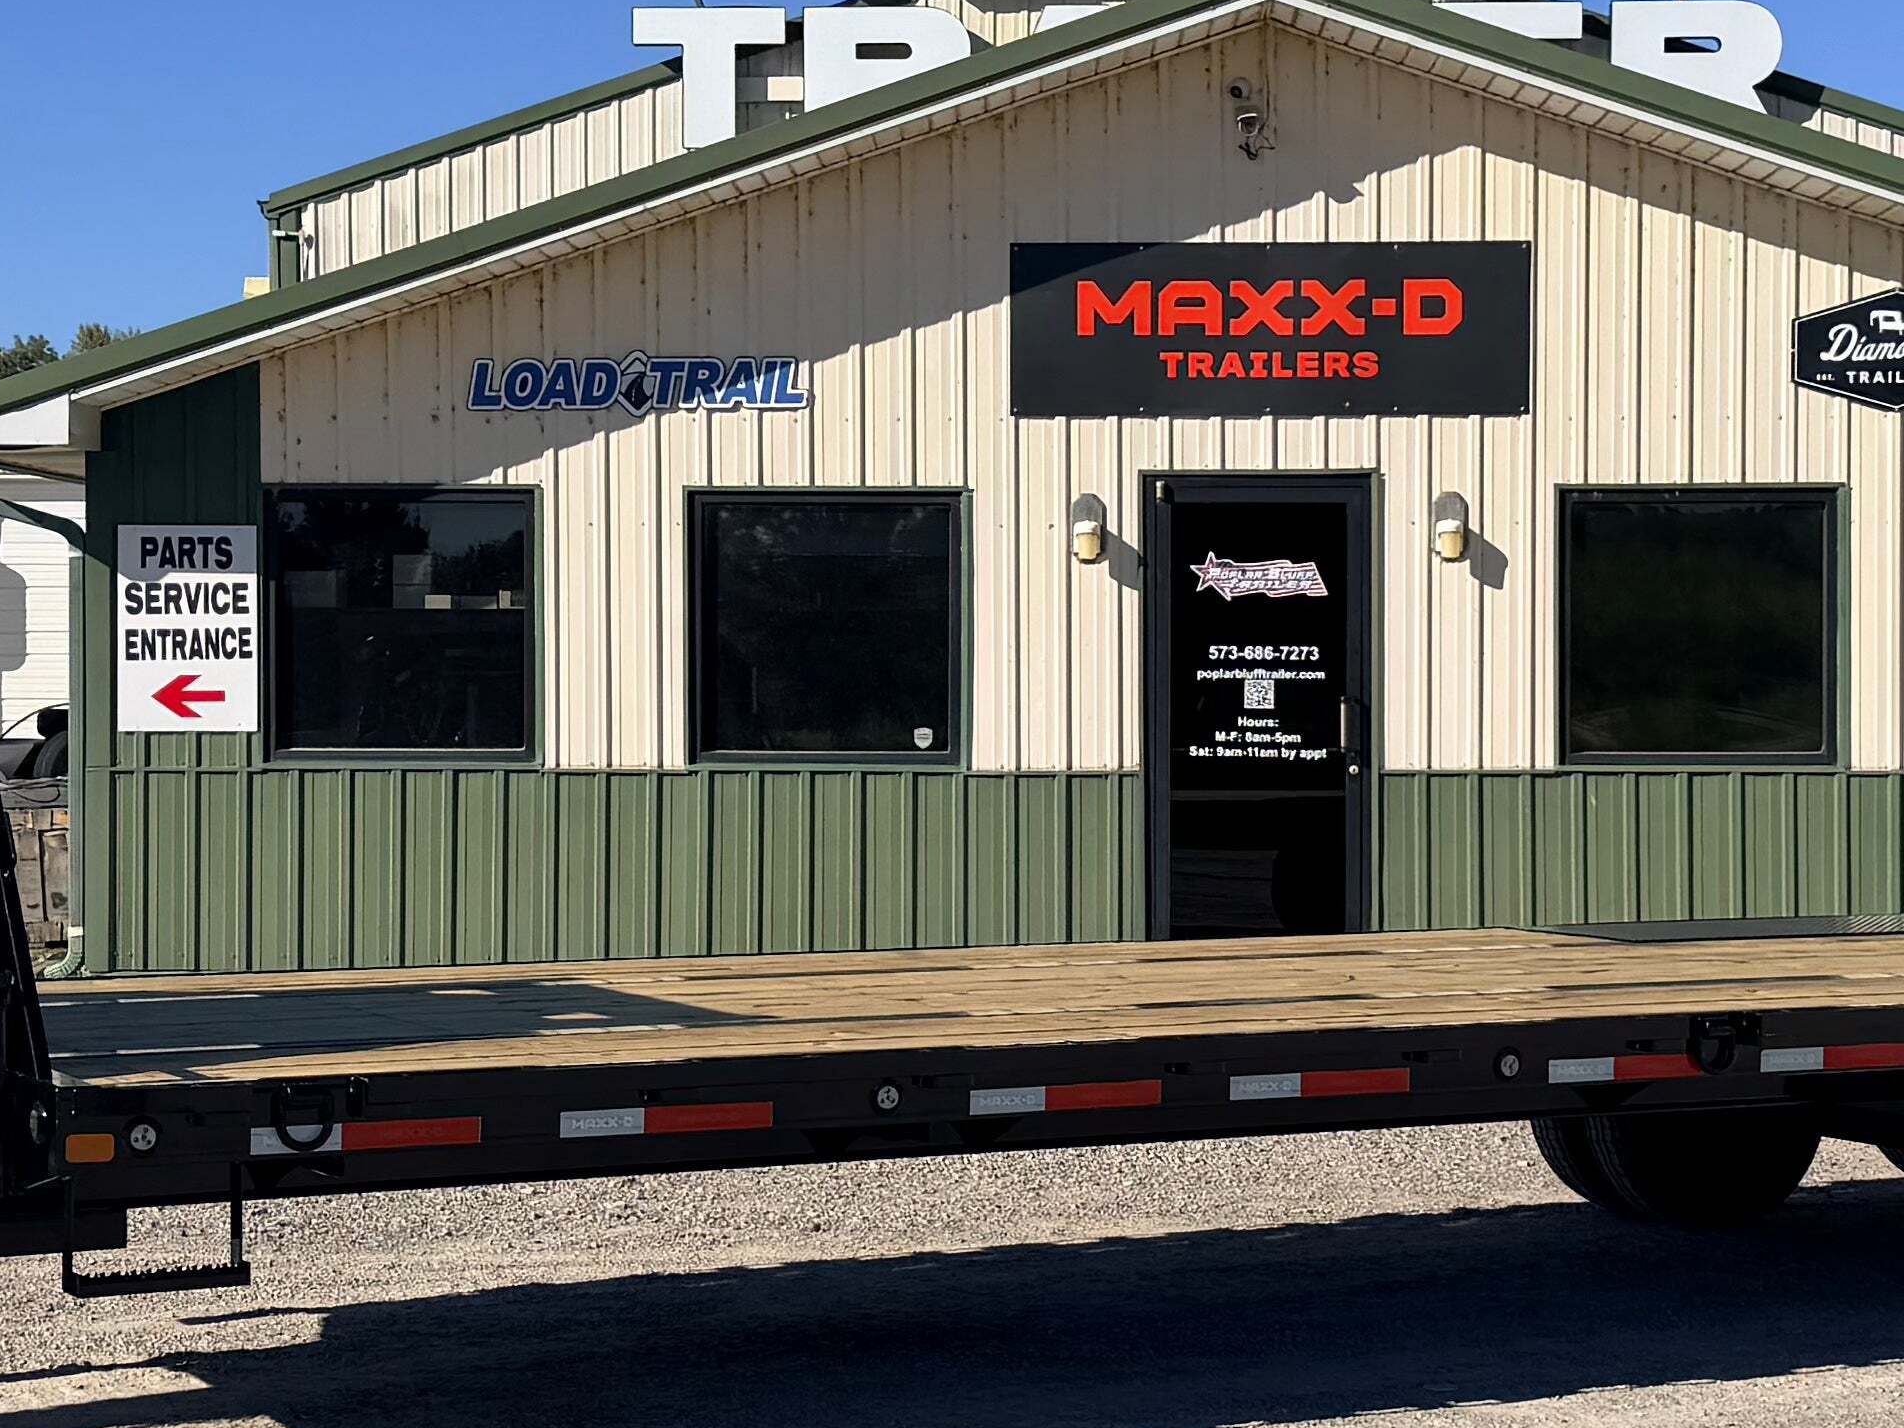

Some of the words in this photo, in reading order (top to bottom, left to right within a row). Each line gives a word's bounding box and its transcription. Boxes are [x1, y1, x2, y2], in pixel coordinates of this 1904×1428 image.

[1076, 278, 1464, 336] MAXX-D
[1159, 351, 1380, 378] TRAILERS
[467, 358, 622, 411] LOAD
[647, 357, 809, 411] TRAIL
[140, 536, 233, 570] PARTS
[125, 582, 250, 615] SERVICE
[125, 627, 253, 661] ENTRANCE
[1208, 645, 1320, 661] 573-686-7273
[1196, 668, 1326, 681] poplarblufftrailer.com
[1237, 716, 1279, 727] Hours:
[1215, 731, 1242, 742] M-F:
[1189, 746, 1213, 757] Sat:
[1281, 747, 1297, 761] by
[1299, 748, 1327, 761] appt
